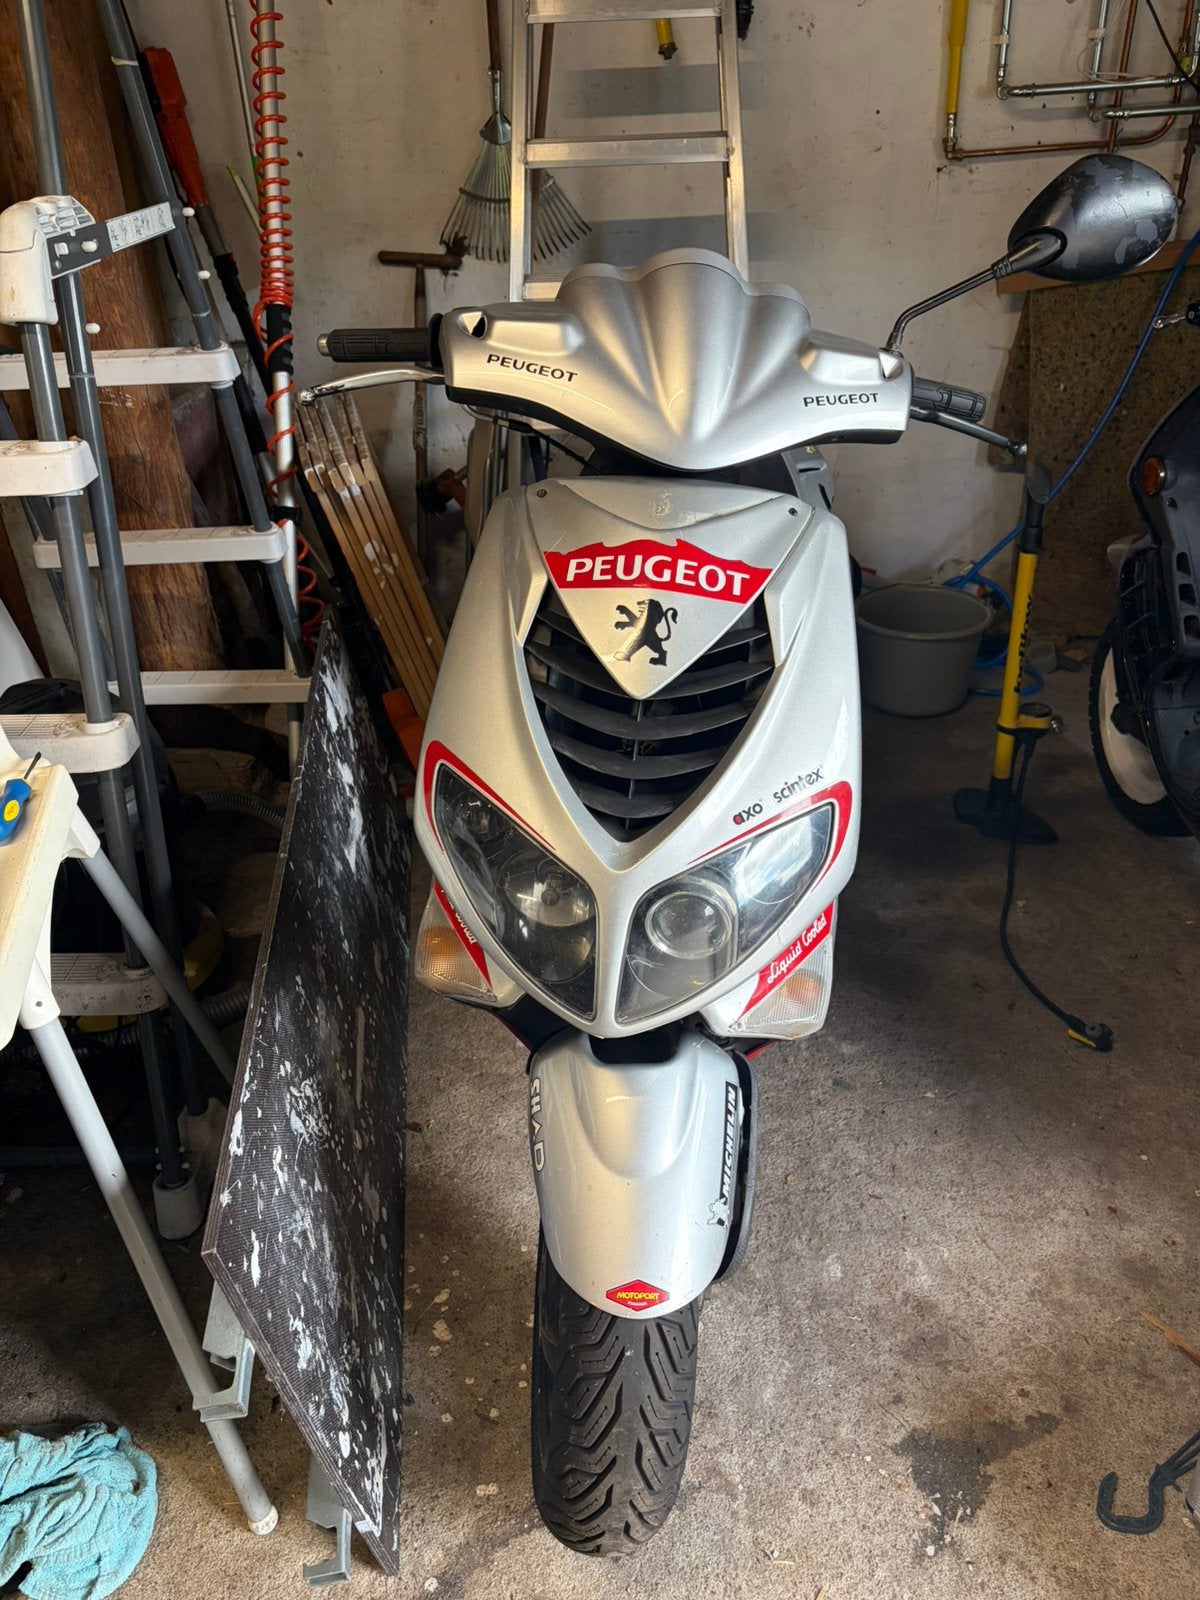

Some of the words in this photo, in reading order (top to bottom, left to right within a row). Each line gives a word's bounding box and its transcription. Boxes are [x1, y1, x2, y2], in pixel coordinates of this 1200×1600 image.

[486, 353, 579, 384] PEUGEOT
[803, 392, 879, 408] PEUGEOT
[565, 554, 750, 596] PEUGEOT
[733, 802, 763, 825] axo
[773, 767, 823, 803] scintex
[767, 941, 803, 984] Liquid
[801, 913, 827, 947] Cooled
[531, 1078, 545, 1172] SHAD
[722, 1086, 737, 1198] MICHELIN
[616, 1291, 660, 1300] MOTOPORT
